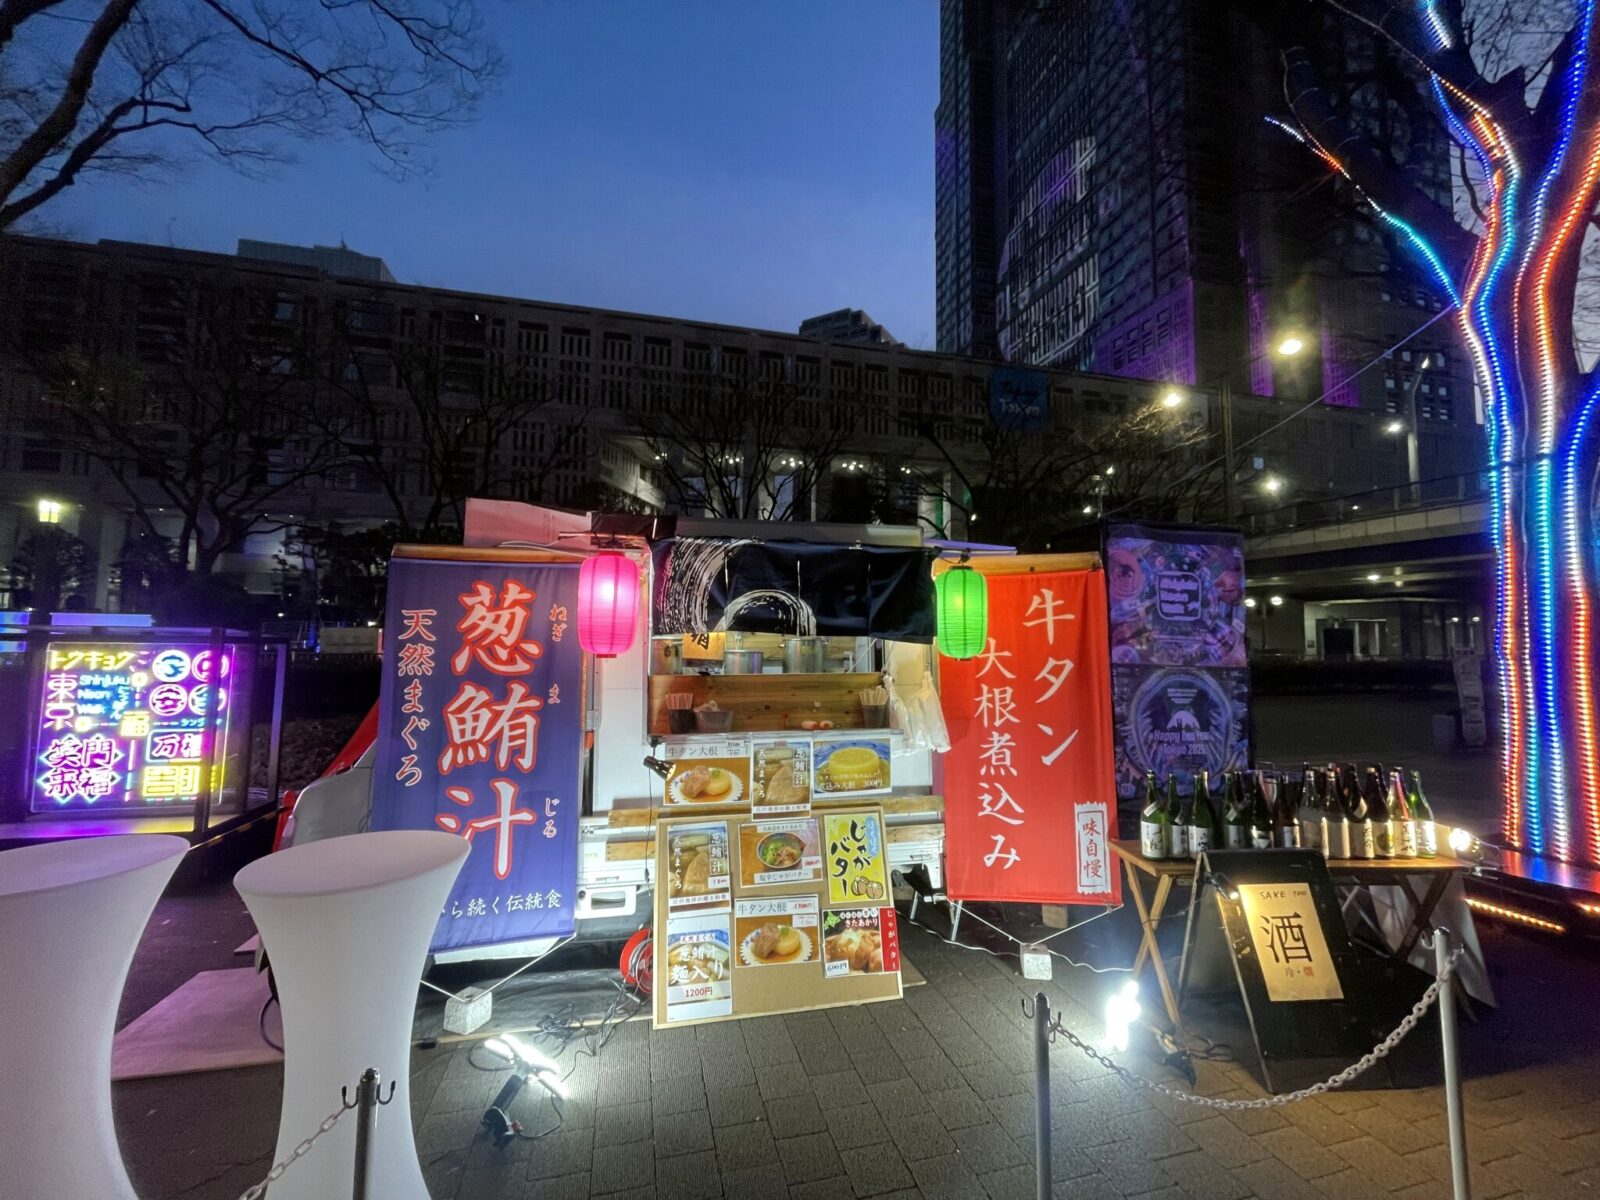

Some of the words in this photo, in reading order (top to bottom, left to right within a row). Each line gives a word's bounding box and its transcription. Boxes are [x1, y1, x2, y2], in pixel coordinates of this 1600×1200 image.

[43, 673, 78, 730] 東京
[79, 674, 130, 688] Shinjuku
[395, 608, 437, 787] 天然まぐろ
[1022, 588, 1079, 767] 牛タン
[434, 578, 544, 881] 葱鮪汁
[973, 637, 1025, 871] 大根煮込み
[1082, 817, 1103, 880] 味自慢
[441, 888, 562, 919] ら続く伝統食
[1259, 891, 1287, 900] SAKE
[1260, 911, 1313, 964] 酒
[685, 986, 713, 998] 1200円
